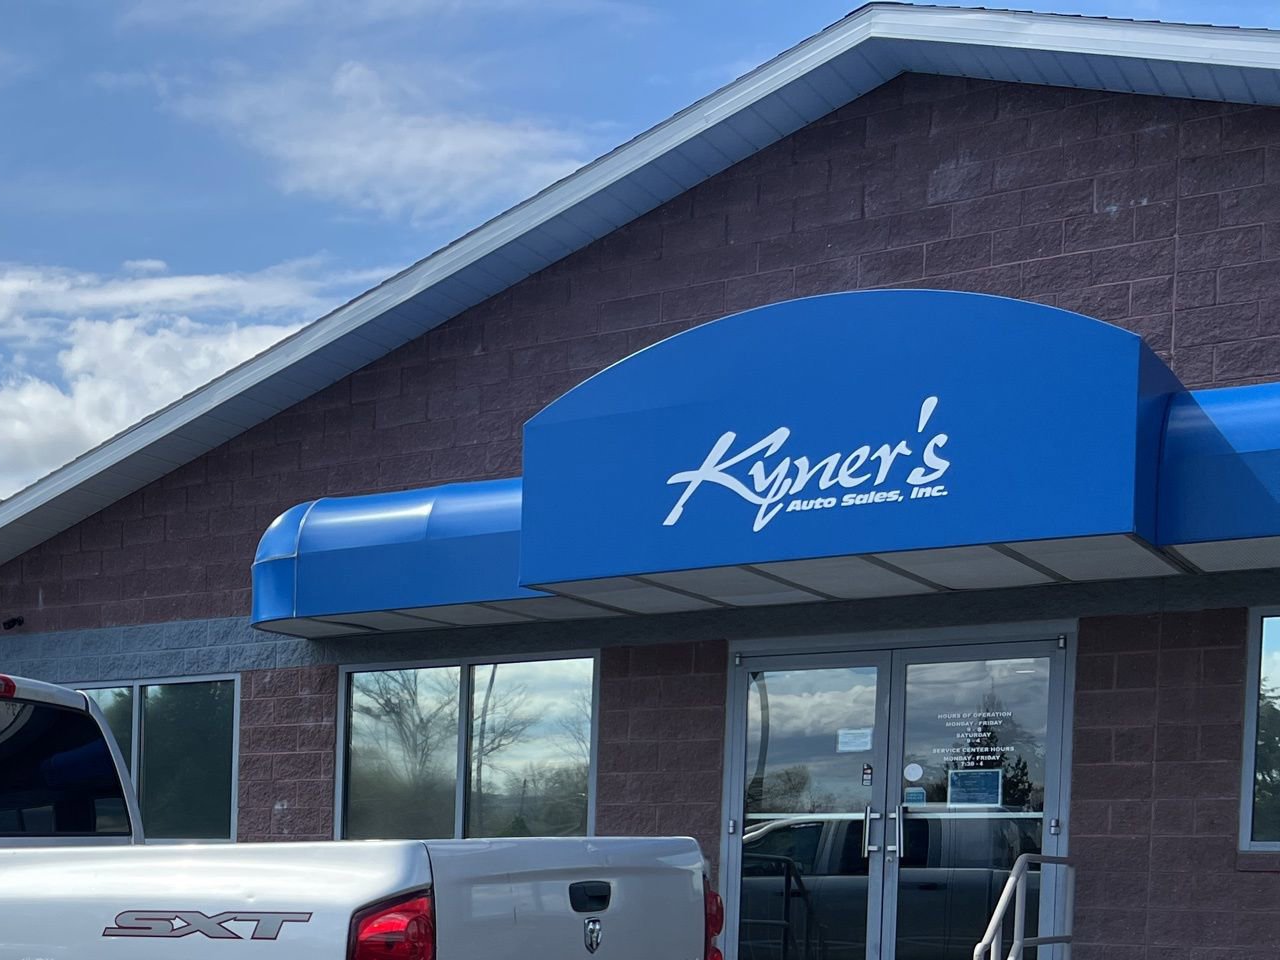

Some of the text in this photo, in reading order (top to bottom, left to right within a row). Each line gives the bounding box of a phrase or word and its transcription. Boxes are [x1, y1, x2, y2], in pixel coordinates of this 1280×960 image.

[662, 396, 950, 532] Kyner's
[786, 485, 949, 512] Auto Sales, Inc.
[102, 910, 313, 940] SXT
